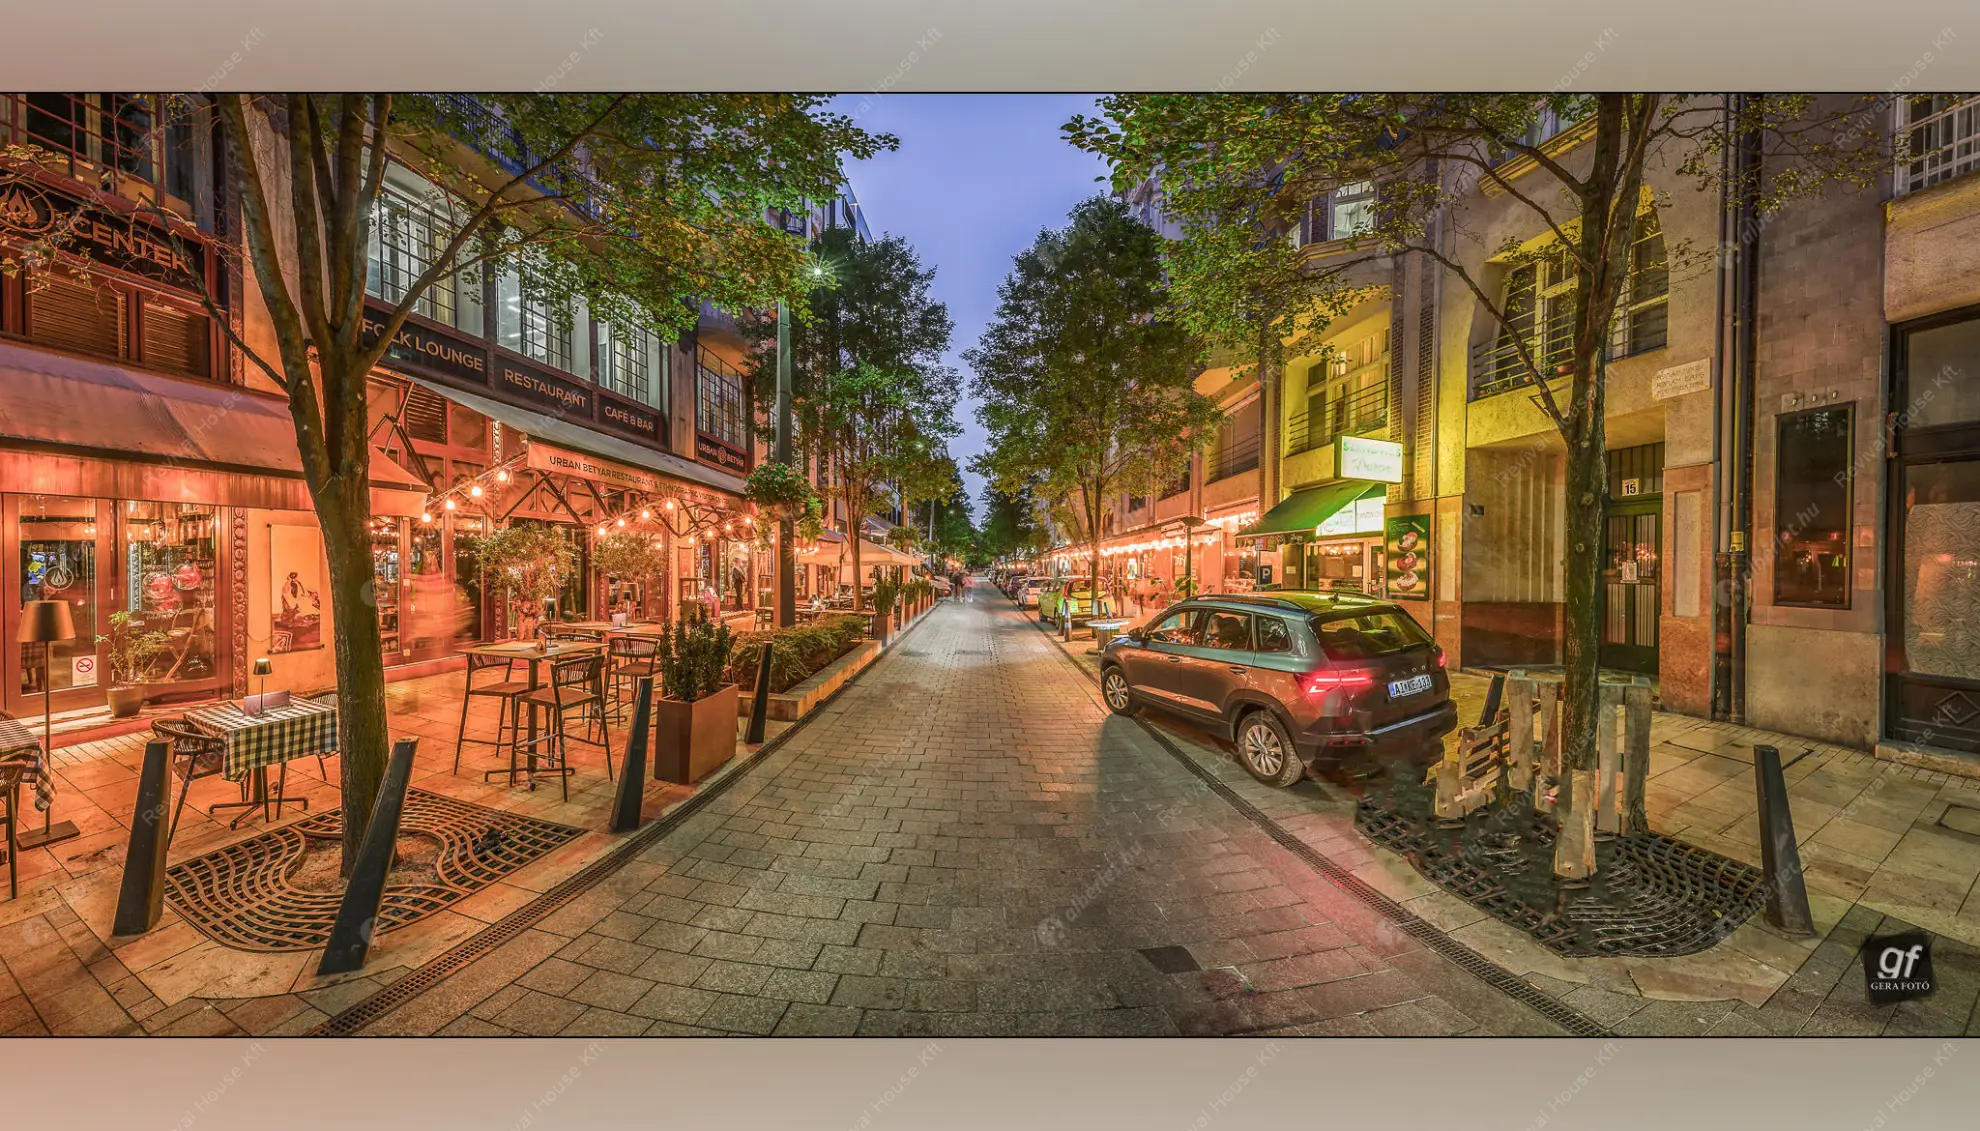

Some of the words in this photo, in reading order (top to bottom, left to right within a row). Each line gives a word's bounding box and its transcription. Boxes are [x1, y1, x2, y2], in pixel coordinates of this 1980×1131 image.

[415, 336, 483, 372] LOUNGE
[503, 368, 586, 409] RESTAURANT
[604, 405, 629, 424] CAFÉ
[637, 416, 653, 432] BAR
[549, 455, 581, 471] URBAN
[611, 470, 653, 488] RESTAURANT
[1625, 484, 1636, 494] 15
[1262, 567, 1270, 579] P
